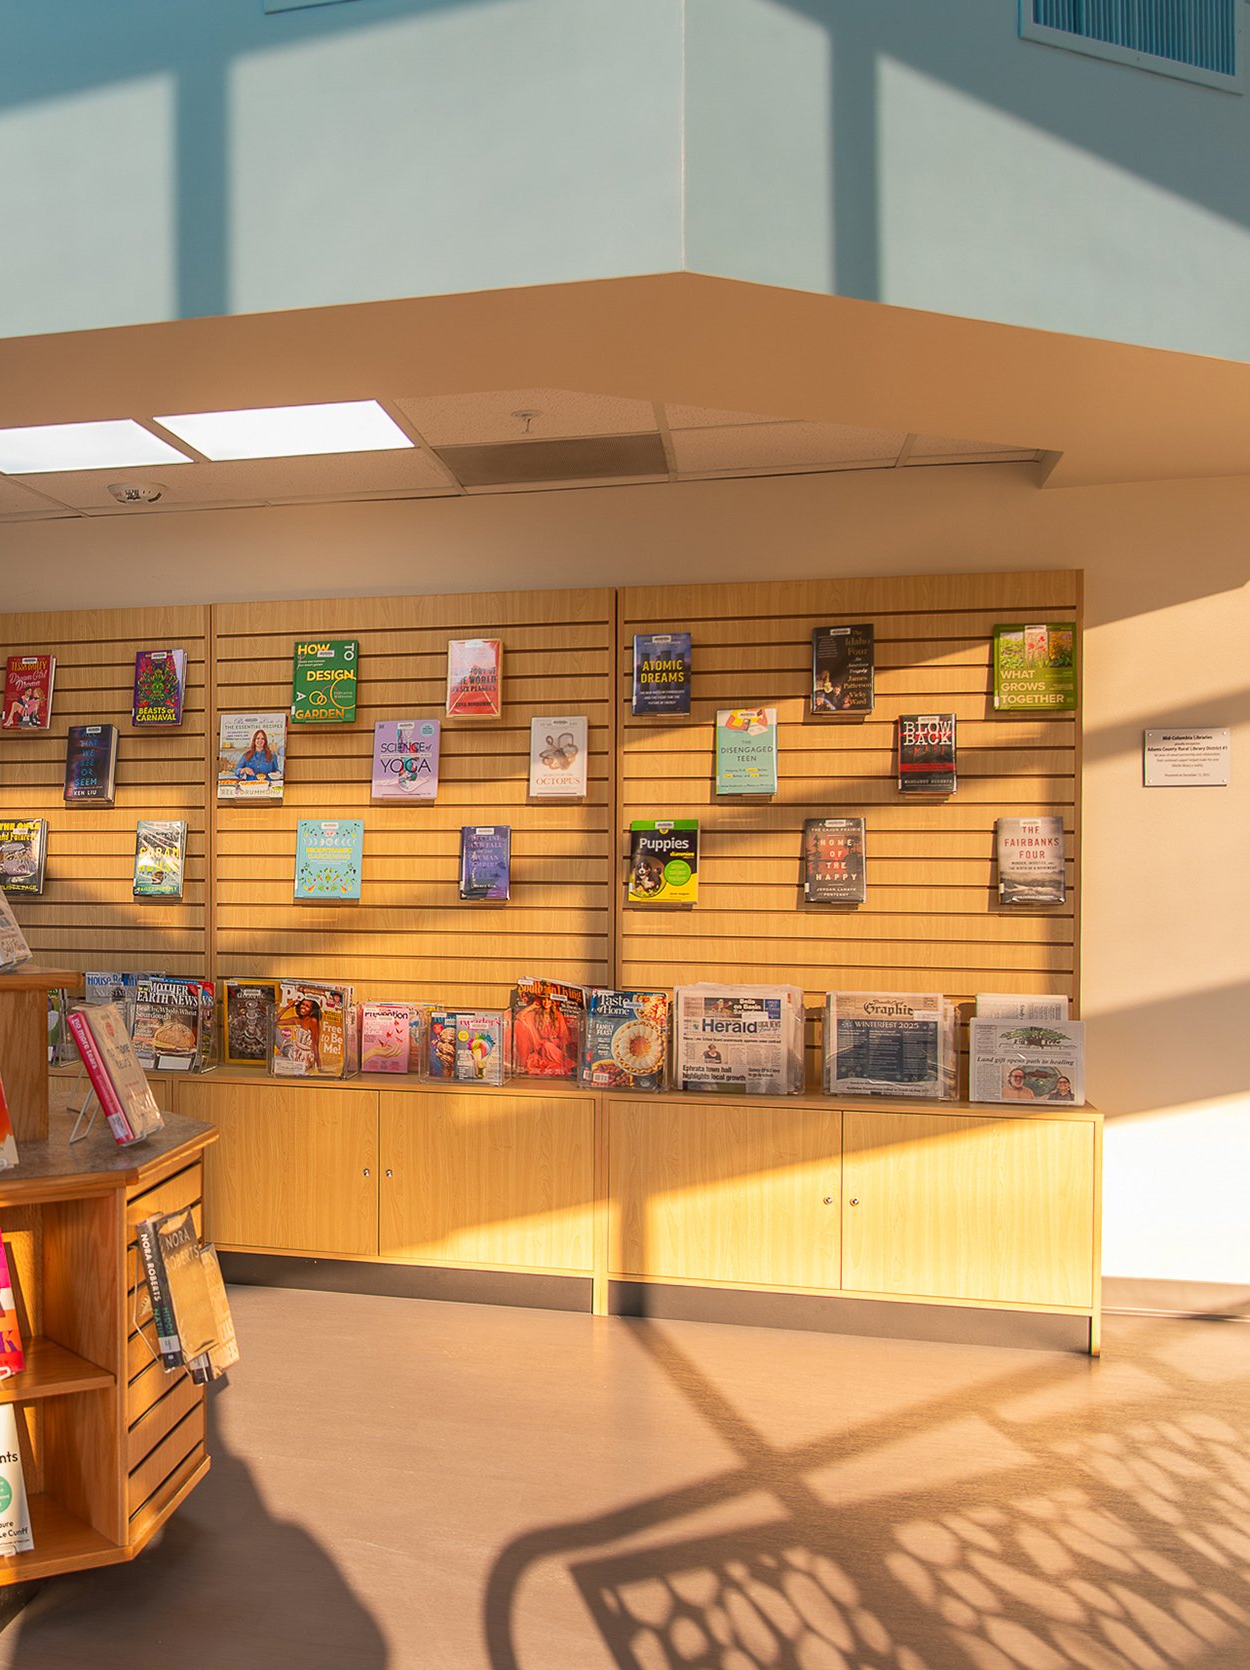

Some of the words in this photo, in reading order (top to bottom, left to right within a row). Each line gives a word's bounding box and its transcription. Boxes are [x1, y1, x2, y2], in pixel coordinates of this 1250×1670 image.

[845, 637, 870, 646] Idaho
[297, 643, 330, 655] HOW
[344, 642, 355, 661] TO
[847, 647, 869, 655] Four
[642, 660, 683, 671] ATOMIC
[306, 669, 354, 681] DESIGN
[469, 675, 497, 684] WORLD
[640, 672, 685, 684] DREAMS
[1000, 670, 1035, 679] WHAT
[1001, 682, 1046, 691] GROWS
[296, 691, 306, 702] A
[1001, 694, 1064, 704] TOGETHER
[138, 707, 165, 715] BEASTS
[295, 708, 345, 719] GARDEN
[903, 720, 952, 735] BLOW
[903, 732, 952, 746] BACK
[381, 742, 425, 753] SCIENCE
[720, 746, 773, 754] DISENGAGED
[80, 759, 95, 767] SEE
[380, 758, 432, 774] YOGA
[80, 768, 93, 776] OR
[74, 778, 98, 786] SEEM
[536, 777, 581, 785] OCTOPUS
[0, 822, 15, 831] THE
[1022, 826, 1040, 834] THE
[639, 837, 690, 852] Puppies
[1004, 838, 1060, 847] FAIRBANKS
[1019, 850, 1046, 859] FOUR
[815, 873, 857, 881] HAPPY
[150, 982, 189, 994] MOTHER
[137, 992, 170, 1003] EARTH
[171, 994, 199, 1006] NEWS
[597, 991, 630, 1006] Taste
[604, 1006, 630, 1015] Home
[863, 1002, 914, 1016] Graphic
[74, 1018, 82, 1029] no
[322, 1021, 342, 1033] Free
[702, 1018, 758, 1033] Herald
[854, 1021, 898, 1029] WINTERFEST
[77, 1027, 90, 1049] more
[321, 1033, 330, 1042] to
[331, 1033, 343, 1043] Be
[323, 1043, 342, 1054] Me!
[85, 1048, 98, 1070] tears
[682, 1065, 705, 1073] Ephrata
[706, 1065, 720, 1073] town
[682, 1073, 710, 1081] highlights
[726, 1074, 746, 1082] growth
[165, 1228, 191, 1249] NORA
[140, 1233, 151, 1261] NORA
[147, 1261, 162, 1302] ROBERTS
[162, 1306, 175, 1336] HIDDE
[7, 1526, 29, 1537] Cunff
